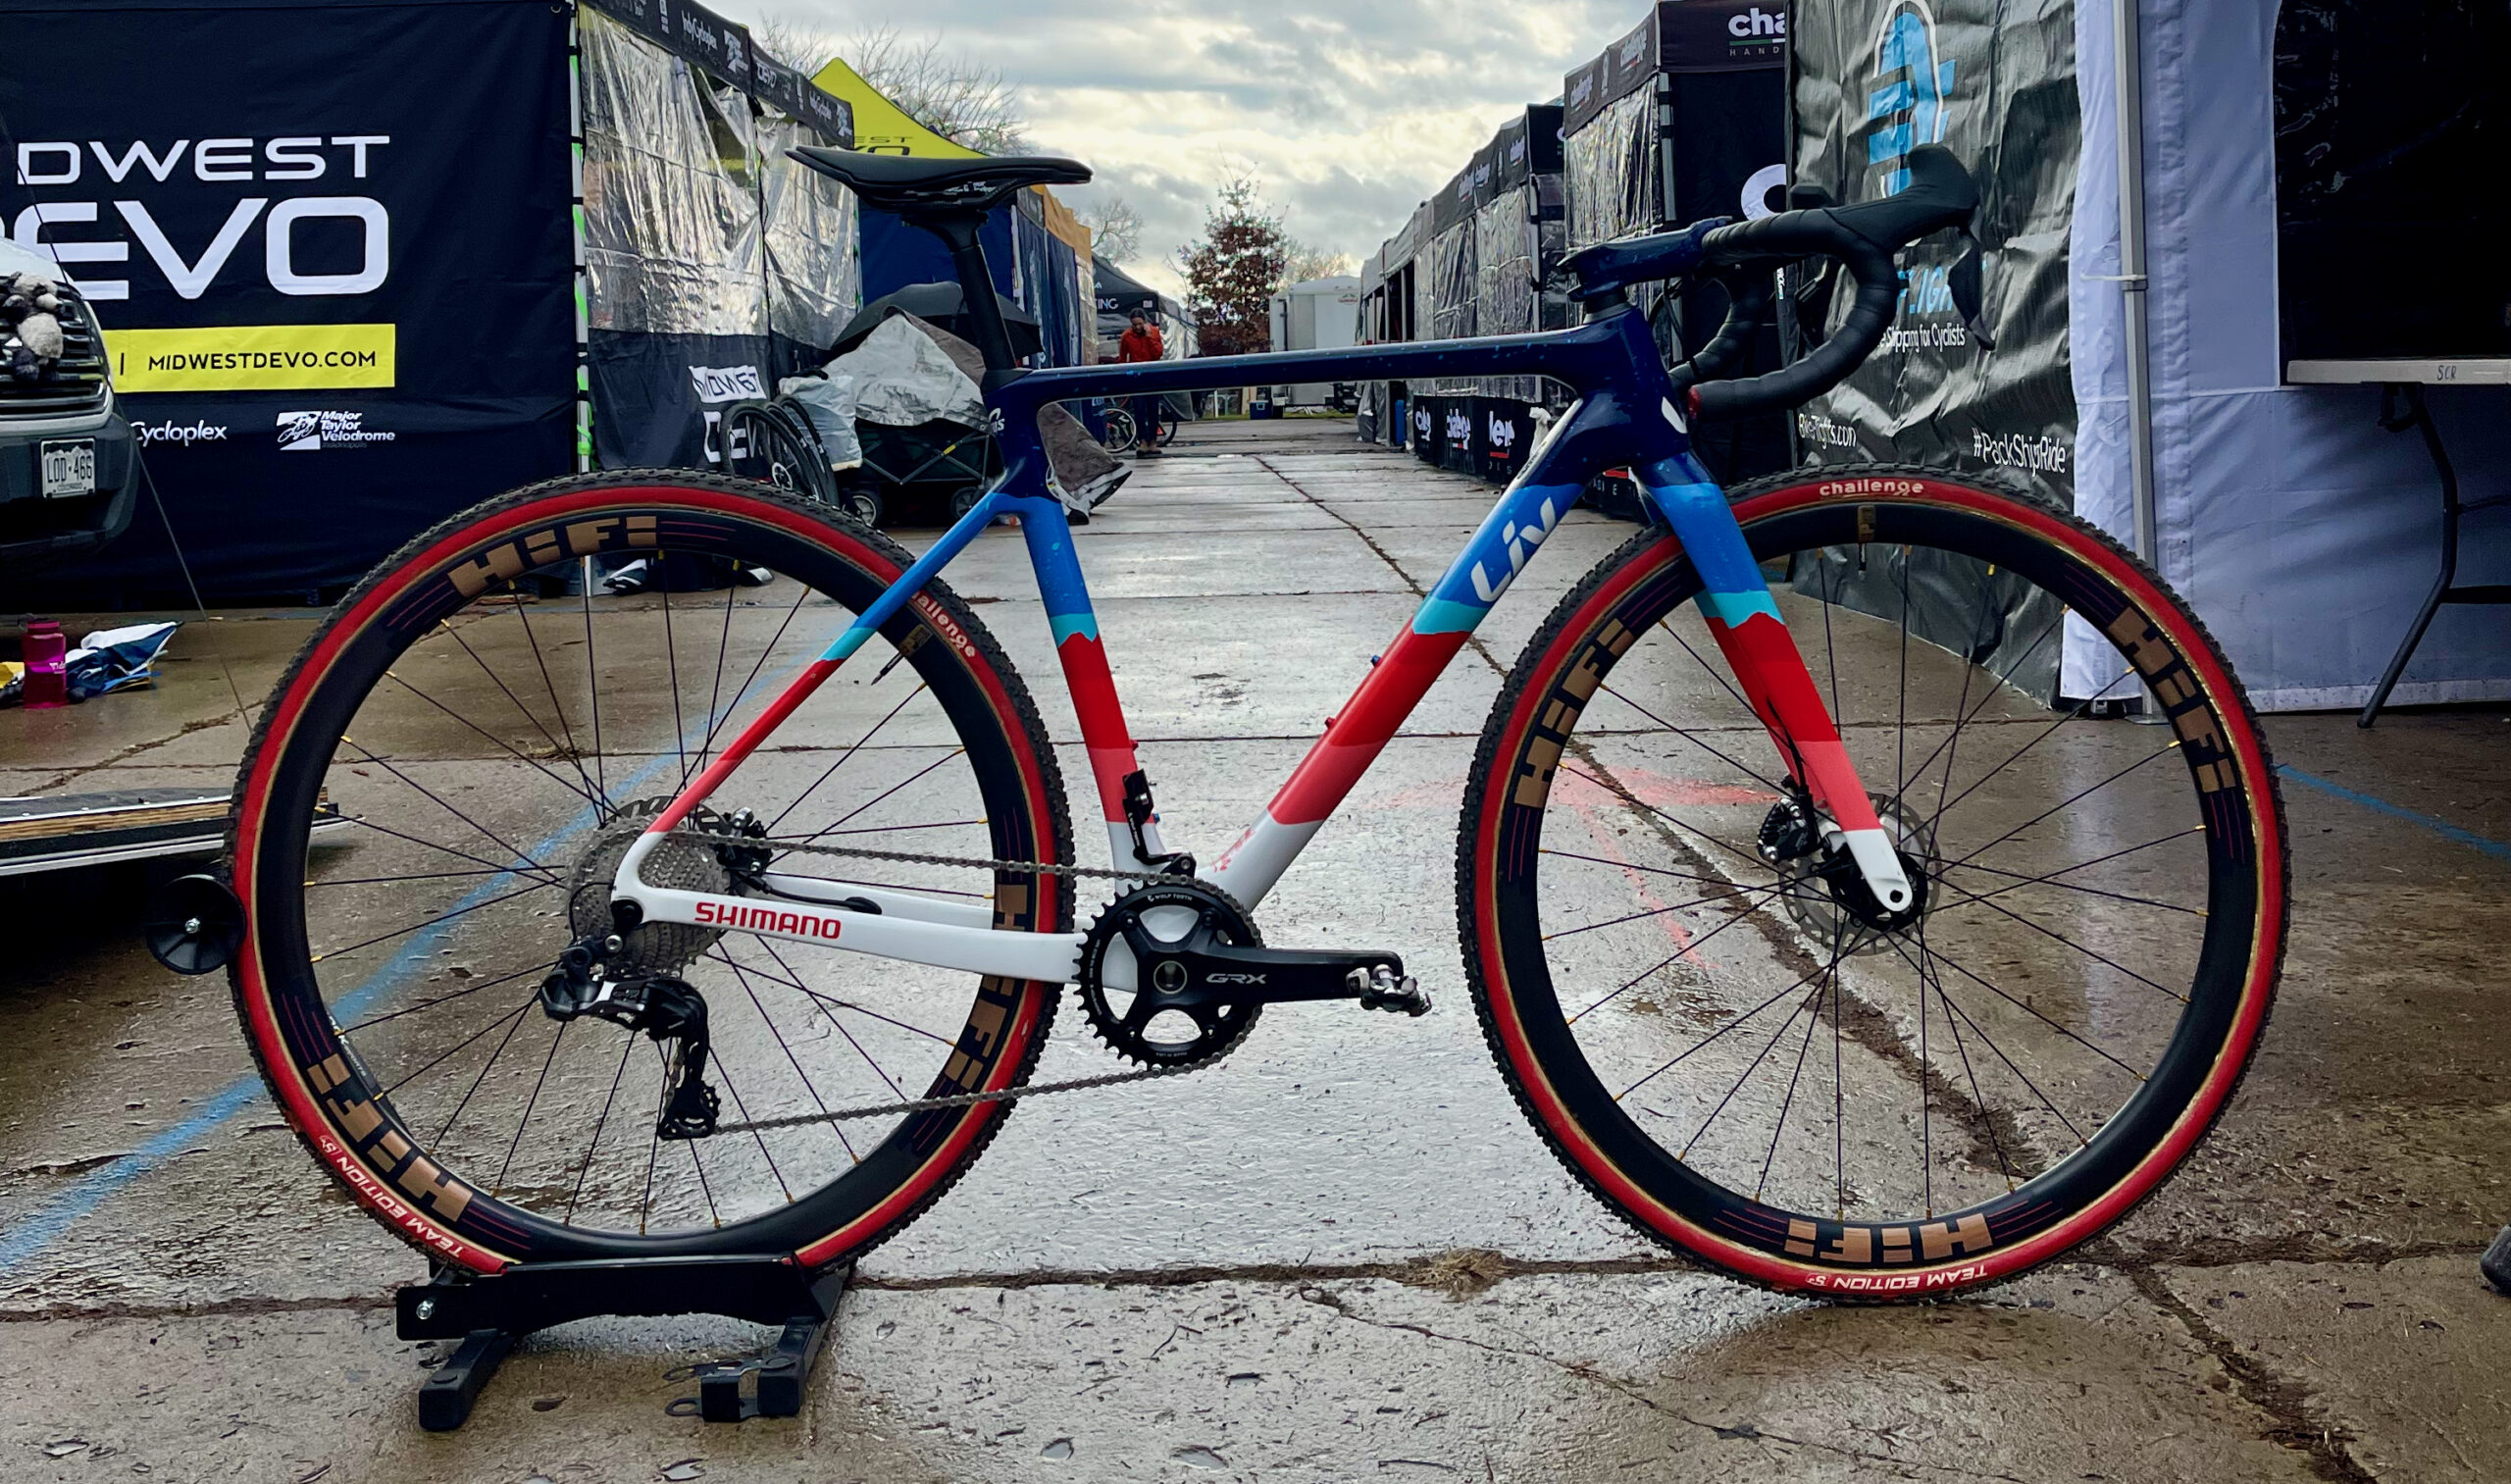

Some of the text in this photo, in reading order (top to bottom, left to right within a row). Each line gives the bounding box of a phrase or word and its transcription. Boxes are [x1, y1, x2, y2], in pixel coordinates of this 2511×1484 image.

[0, 196, 389, 300] EVO
[1096, 297, 1119, 310] ING
[1919, 323, 1931, 347] for
[1930, 322, 1966, 352] Cyclists
[148, 350, 377, 372] MIDWESTDEVO.COM
[320, 410, 363, 422] Major
[320, 420, 362, 433] Taylor
[321, 431, 396, 441] Velodrome
[1972, 427, 2067, 478] #PackShipRide
[1819, 479, 1923, 497] challenge
[1471, 496, 1557, 602] Liv
[694, 901, 843, 940] SHIMANO
[1205, 973, 1267, 985] GRX
[335, 1156, 407, 1217] EDITION
[405, 1216, 466, 1258] TEAM
[1833, 1276, 1922, 1291] EDITION
[1926, 1265, 1988, 1287] TEAM
